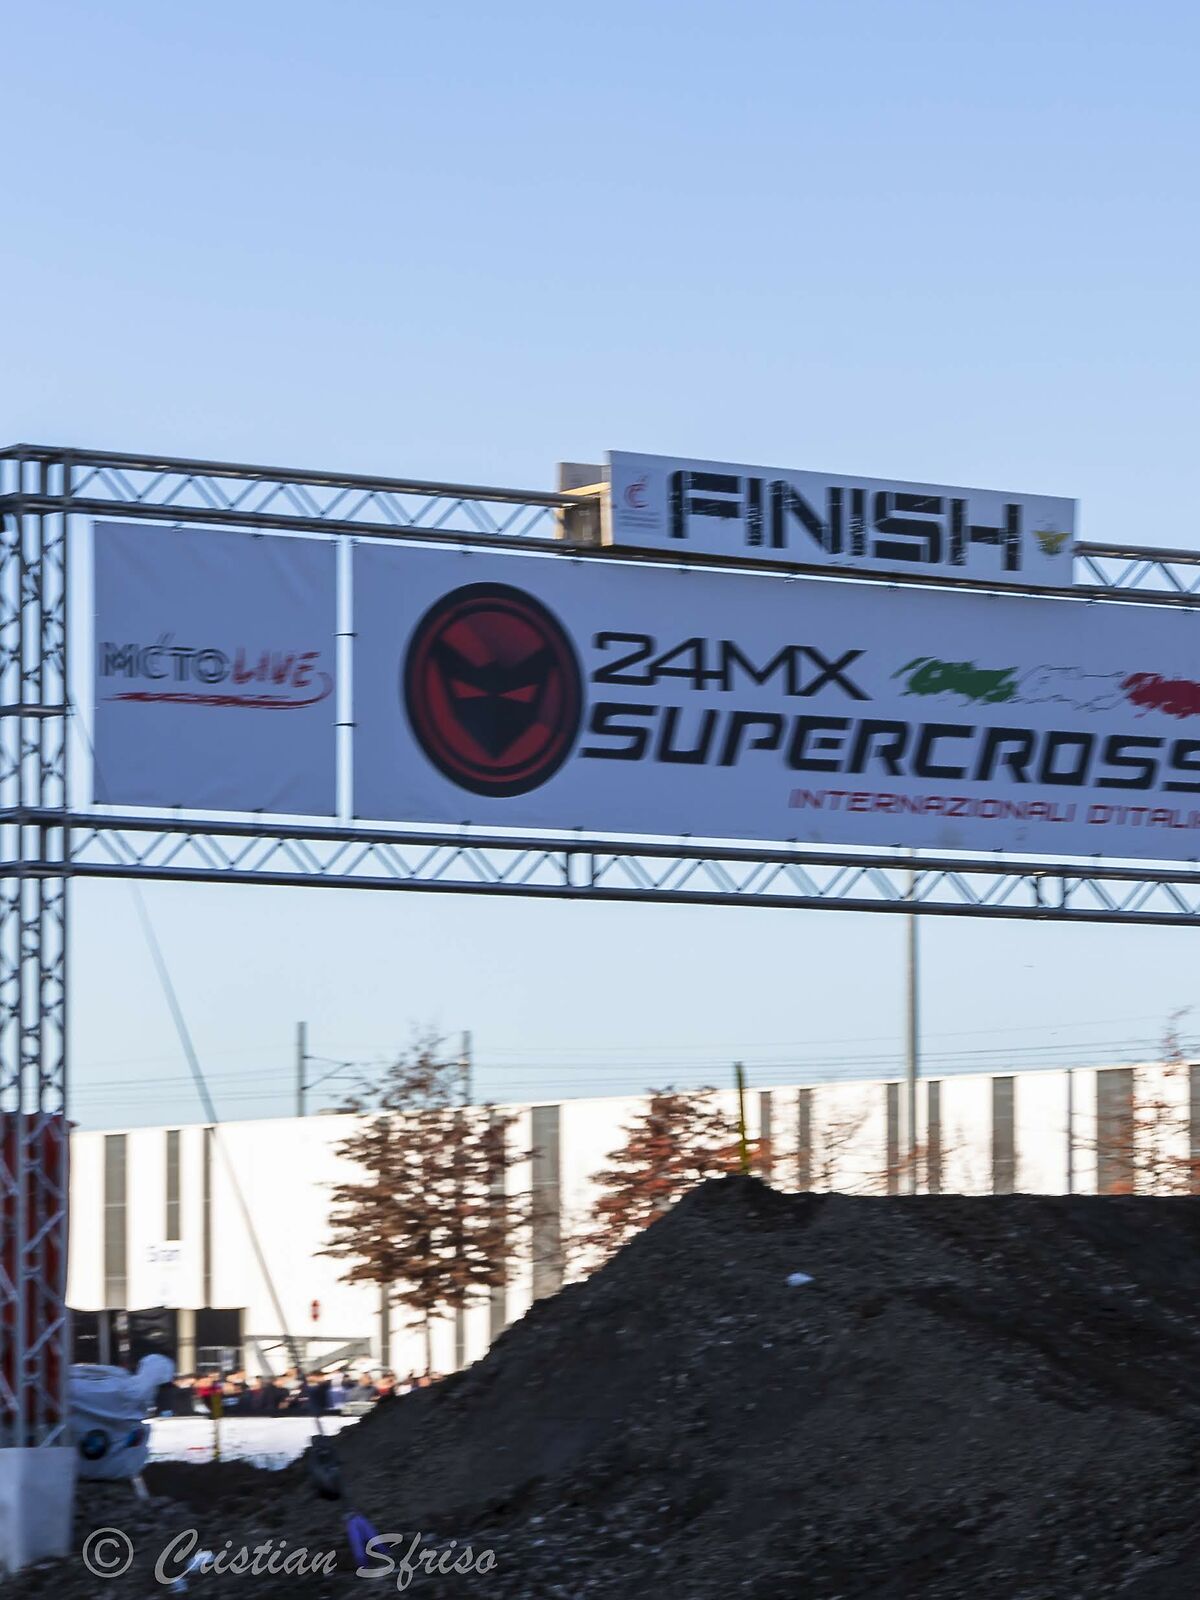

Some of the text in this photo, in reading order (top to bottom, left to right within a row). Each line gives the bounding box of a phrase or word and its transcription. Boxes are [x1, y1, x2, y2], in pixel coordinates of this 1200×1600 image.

[668, 470, 1023, 571] FINISH
[592, 631, 873, 701] 24MX
[788, 788, 1076, 823] INTERNAZIONALI
